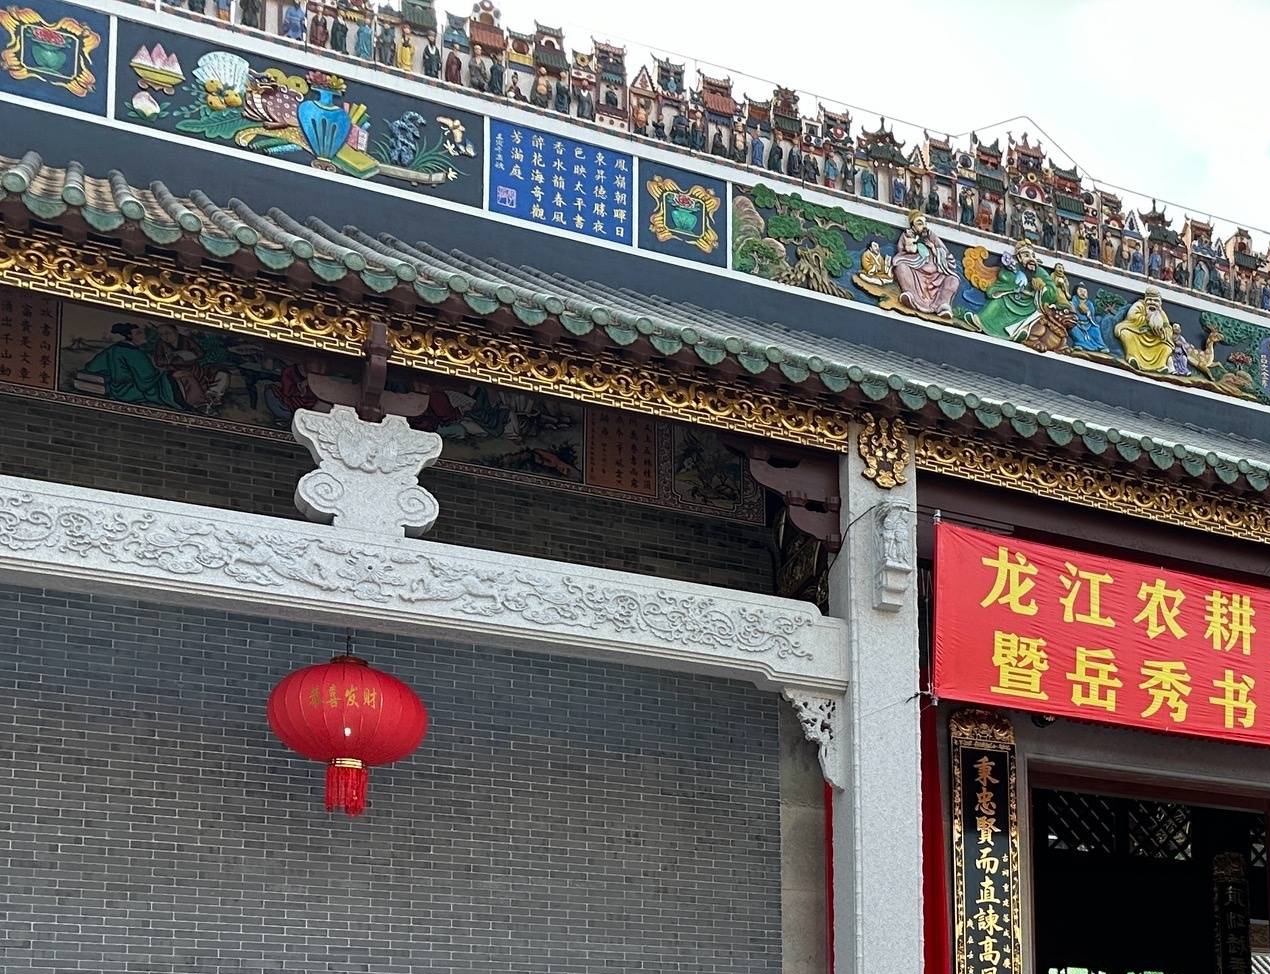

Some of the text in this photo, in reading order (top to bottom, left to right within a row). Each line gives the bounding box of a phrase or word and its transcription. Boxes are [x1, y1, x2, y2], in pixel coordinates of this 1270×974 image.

[573, 147, 588, 230] 色映太平書
